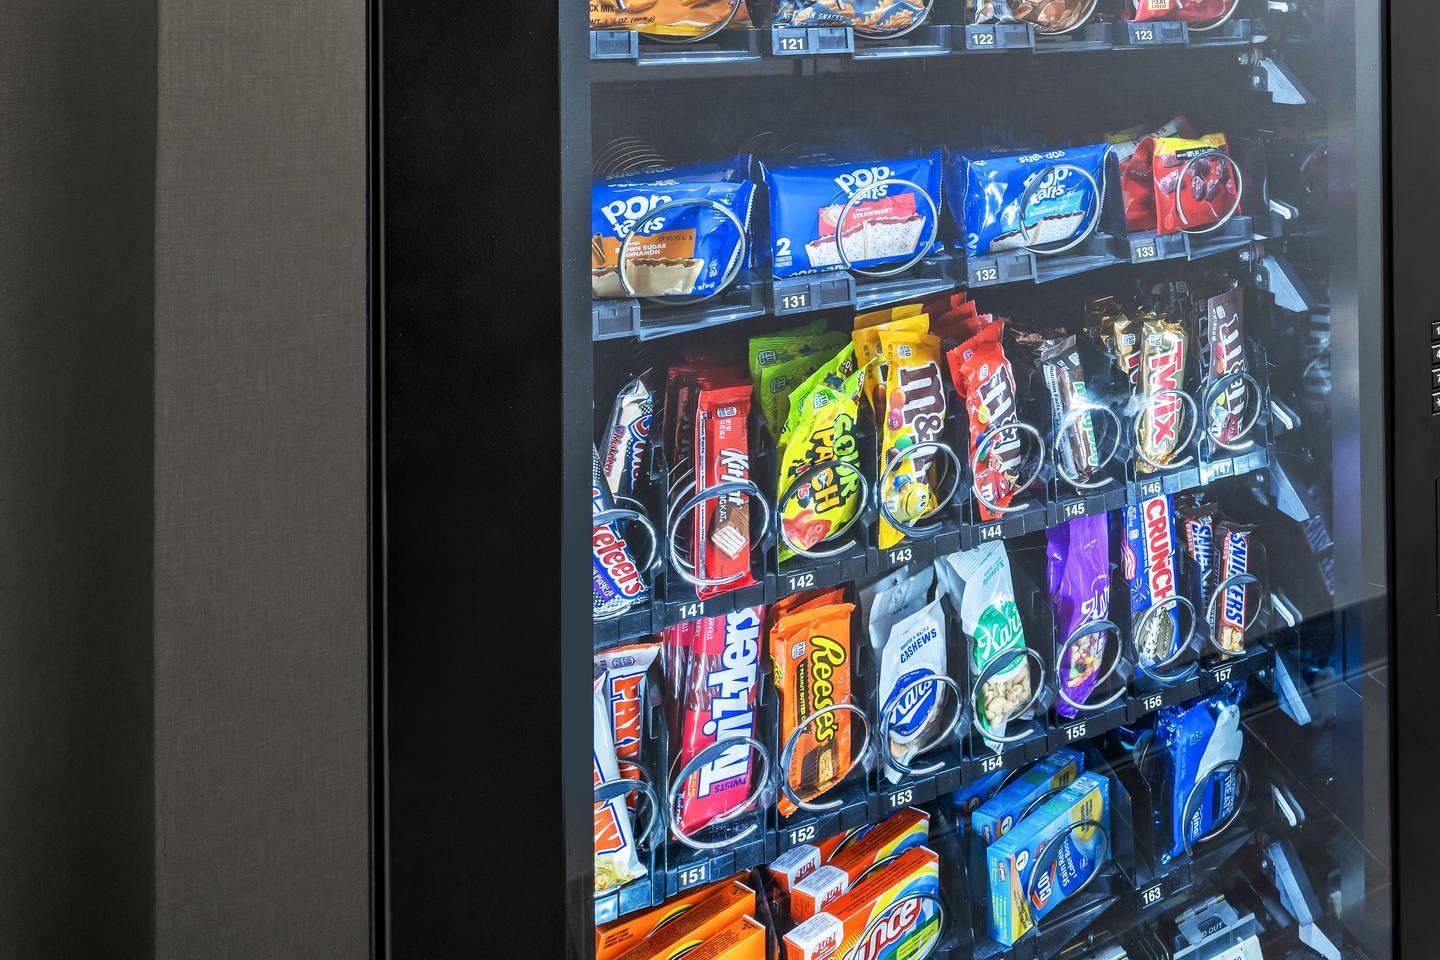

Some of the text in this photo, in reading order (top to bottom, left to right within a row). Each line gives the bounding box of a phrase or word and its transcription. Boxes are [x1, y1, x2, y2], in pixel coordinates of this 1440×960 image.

[780, 38, 805, 50] 121
[972, 34, 994, 45] 122
[1134, 31, 1153, 41] 123
[851, 207, 893, 220] STRAWBERRY
[642, 242, 667, 251] SUGAR
[776, 237, 792, 256] 2
[968, 232, 979, 249] 2
[1135, 246, 1155, 258] 133
[974, 268, 997, 282] 132
[782, 295, 806, 309] 131
[1436, 327, 1440, 336] 1
[833, 413, 861, 500] SOUR
[809, 426, 840, 515] PATCH
[1213, 462, 1231, 475] 147
[1142, 482, 1161, 495] 146
[1064, 503, 1086, 516] 145
[981, 526, 1003, 540] 144
[889, 548, 913, 564] 143
[788, 574, 815, 590] 142
[679, 601, 706, 619] 141
[899, 627, 938, 664] CASHEWS
[1214, 669, 1232, 683] 157
[810, 635, 847, 742] Reese's
[1143, 695, 1162, 711] 156
[1065, 724, 1087, 740] 155
[981, 757, 1004, 773] 154
[714, 778, 748, 794] TWISTS
[889, 790, 913, 807] 153
[789, 826, 816, 845] 152
[679, 867, 707, 886] 151
[1058, 864, 1070, 887] Stain
[1142, 887, 1162, 905] 163
[1207, 921, 1224, 935] OUT
